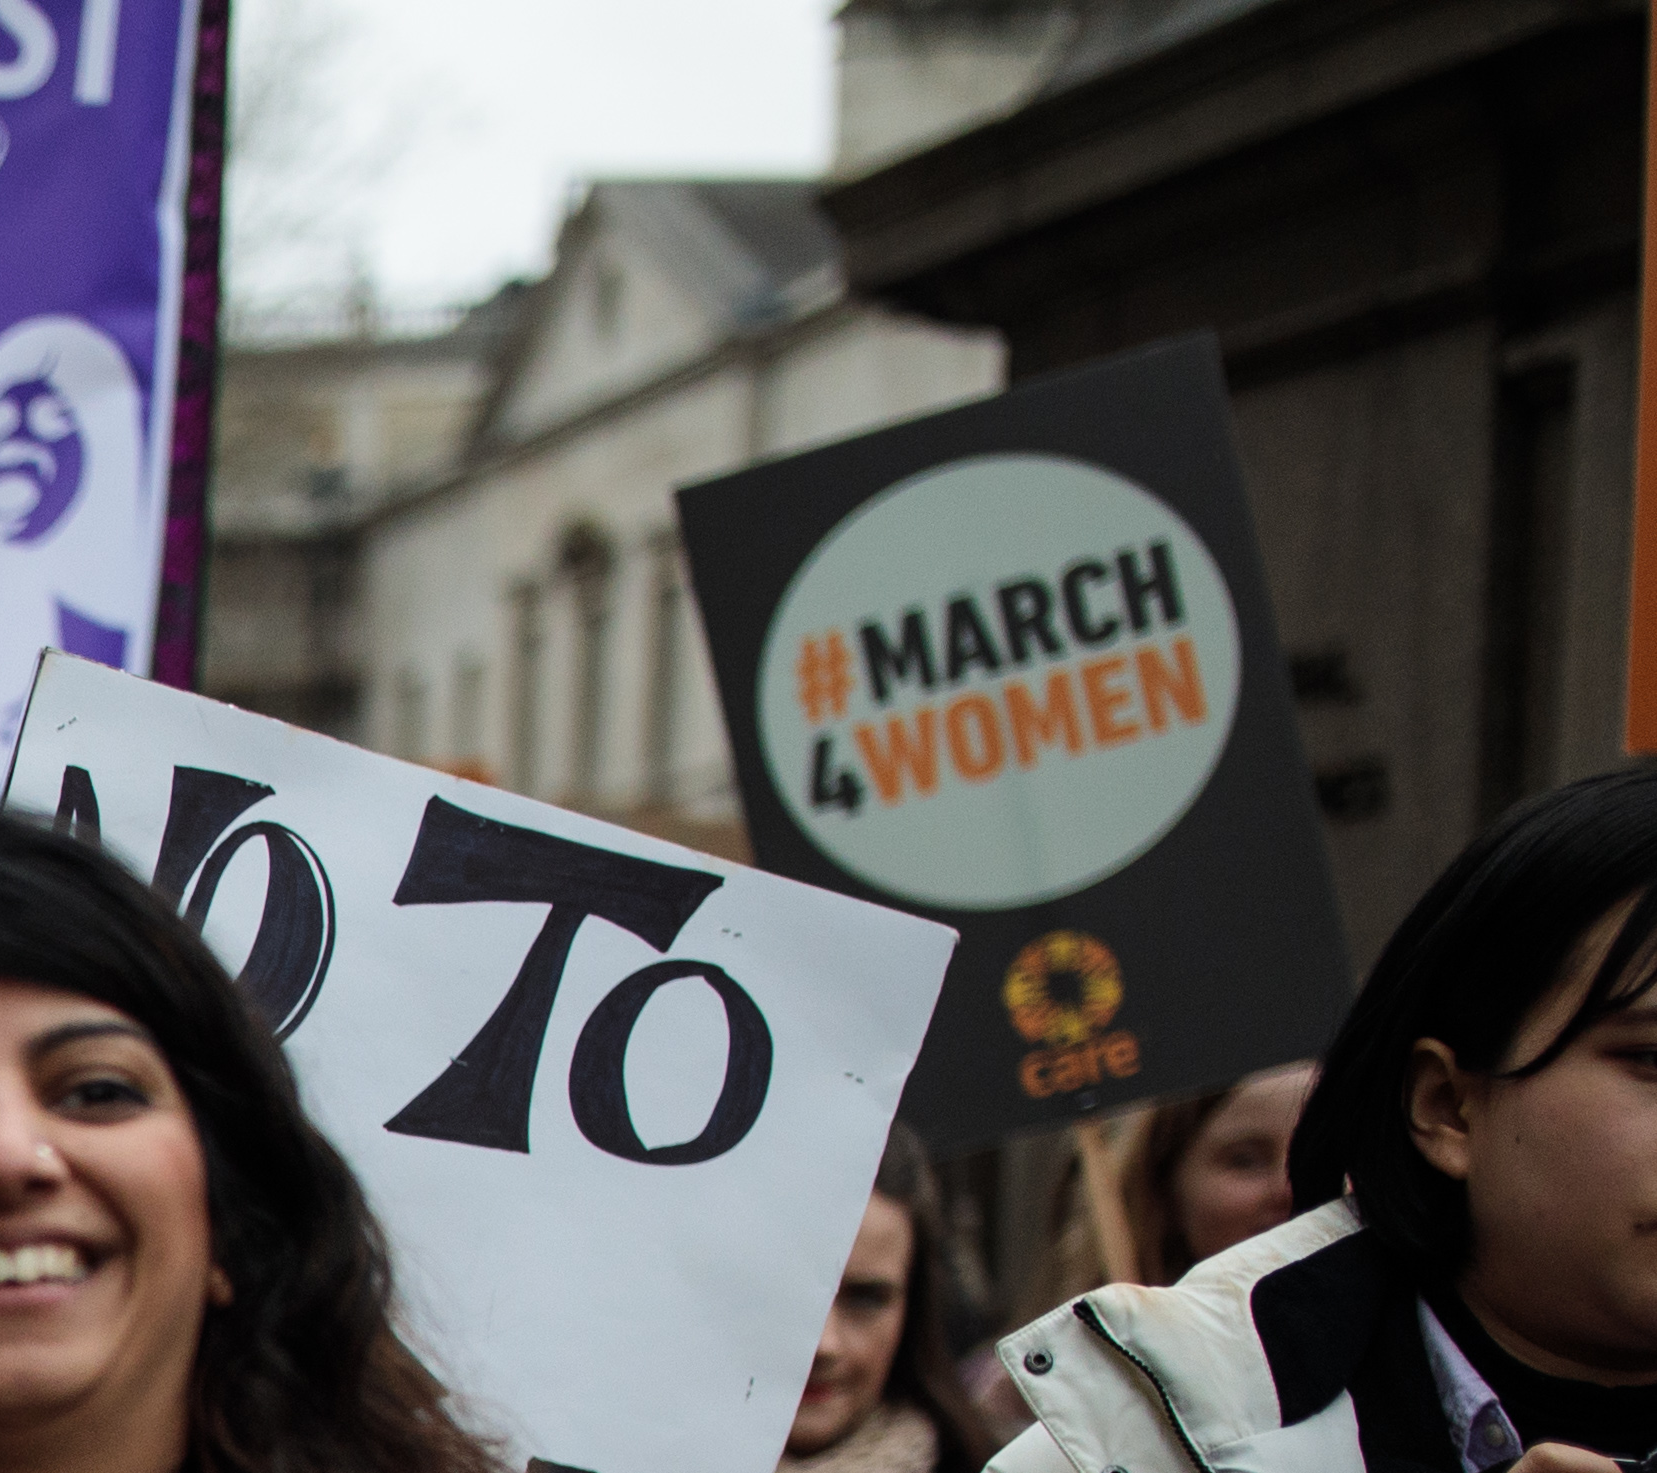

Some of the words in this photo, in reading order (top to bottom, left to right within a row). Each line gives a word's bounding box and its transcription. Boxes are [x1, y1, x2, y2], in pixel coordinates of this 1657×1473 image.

[794, 537, 1188, 728] #MARCH
[806, 633, 1210, 818] 4WOMEN
[1018, 1028, 1142, 1098] care
